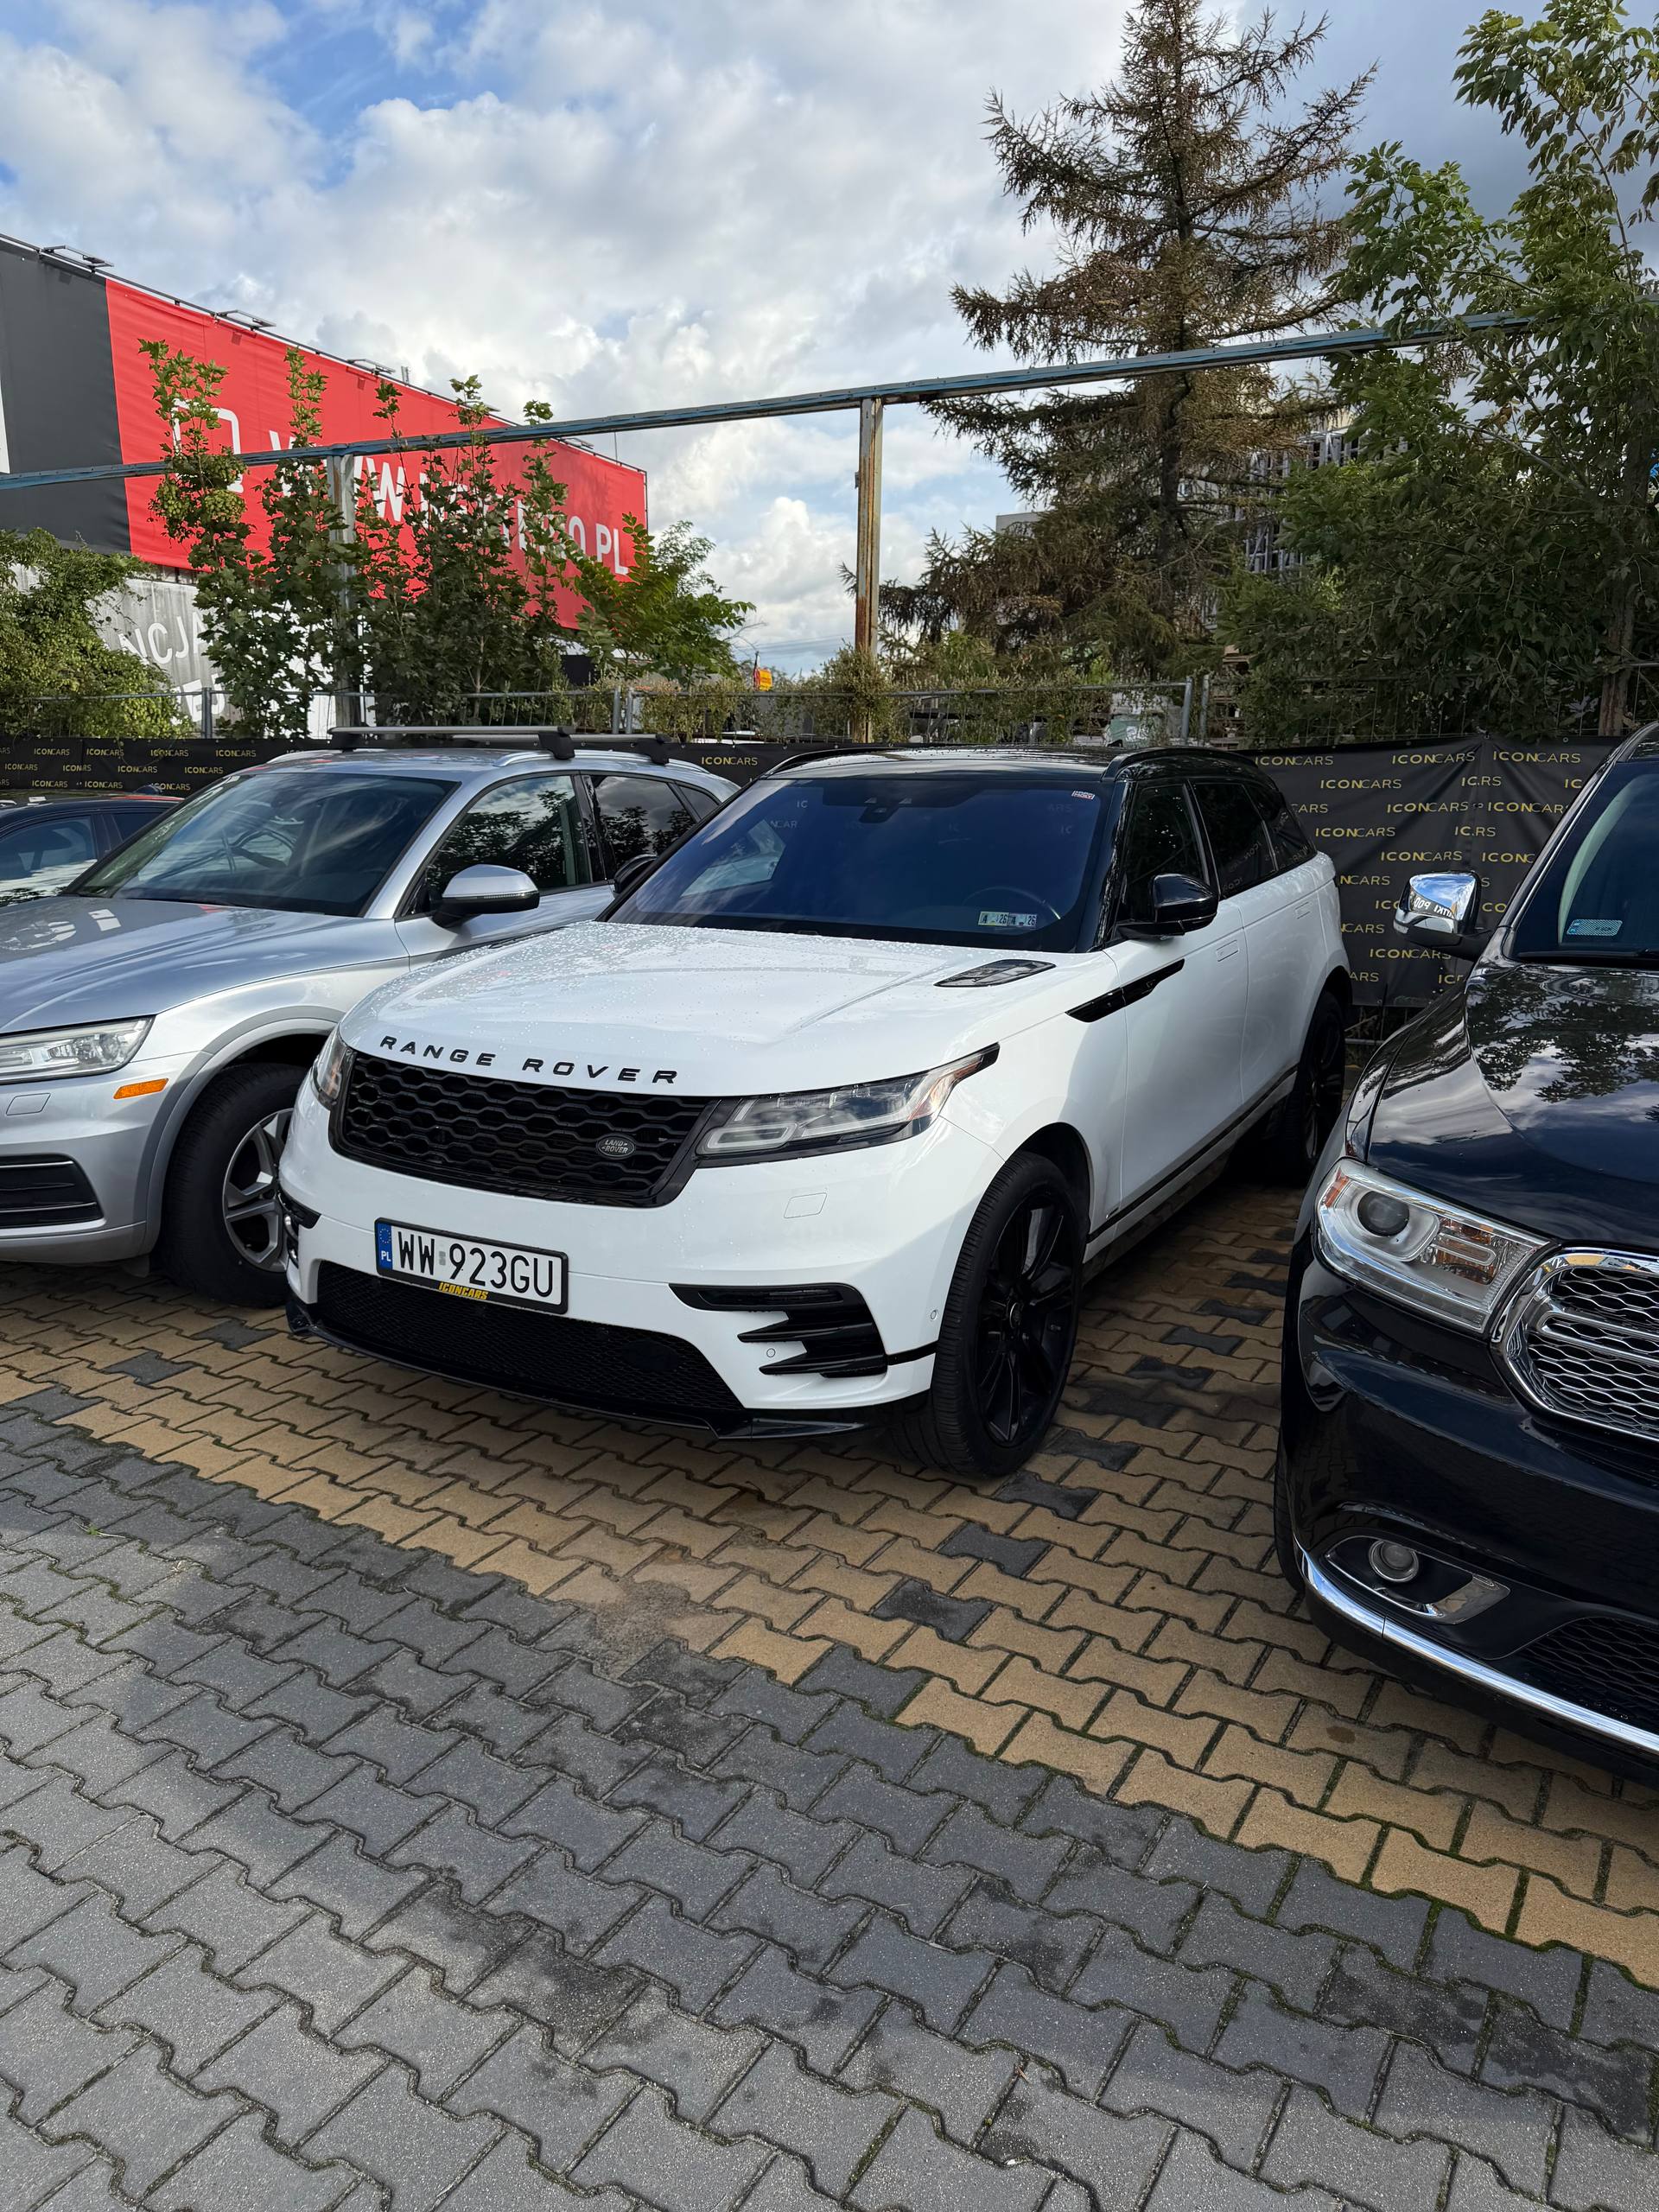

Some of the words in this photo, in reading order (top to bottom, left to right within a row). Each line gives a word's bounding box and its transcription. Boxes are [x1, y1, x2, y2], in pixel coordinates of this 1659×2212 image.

[701, 756, 758, 766] ICONCARS
[1255, 755, 1334, 766] ICONCARS
[1392, 751, 1475, 764] ICONCARS
[1493, 751, 1580, 763] ICONCARS
[4, 763, 38, 772] ICONCARS
[118, 765, 157, 773] ICONCARS
[85, 780, 123, 789] ICONCARS
[1320, 779, 1402, 789] ICONCARS
[1387, 801, 1468, 813] ICONCARS
[1488, 801, 1569, 813] ICONCAR
[1315, 827, 1395, 837] ICONCARS
[1380, 850, 1462, 861] ICONCARS
[379, 1035, 496, 1066] RANGE
[522, 1058, 678, 1084] ROVER
[381, 1250, 391, 1262] PL
[398, 1231, 435, 1275] WW
[449, 1243, 553, 1298] 923GU
[438, 1281, 489, 1300] ICONCARS
